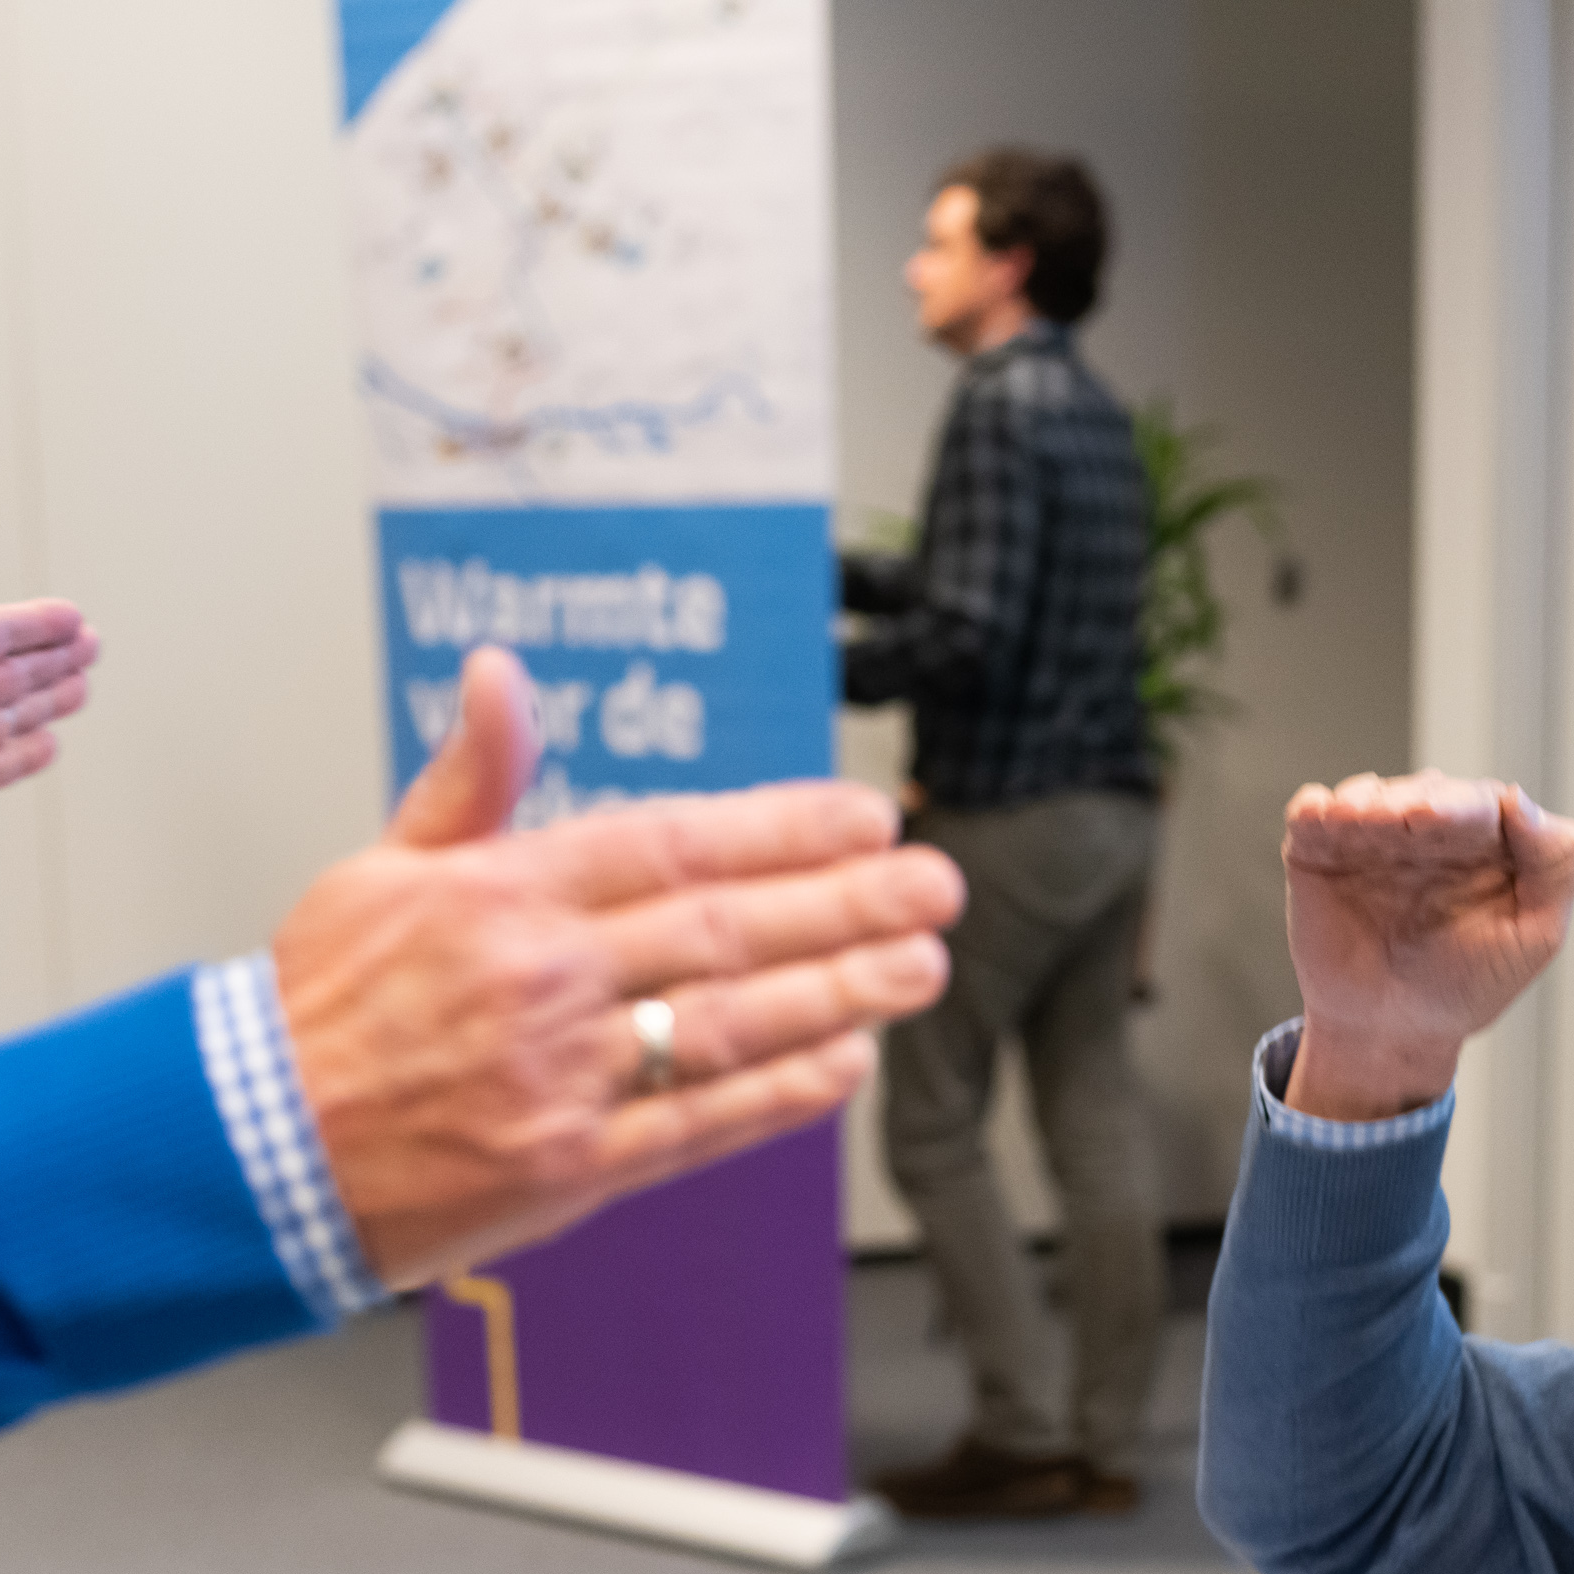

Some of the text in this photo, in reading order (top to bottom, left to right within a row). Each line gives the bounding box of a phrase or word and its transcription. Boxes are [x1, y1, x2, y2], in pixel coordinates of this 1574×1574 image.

[398, 556, 727, 652] Warmte
[405, 662, 704, 761] vr de
